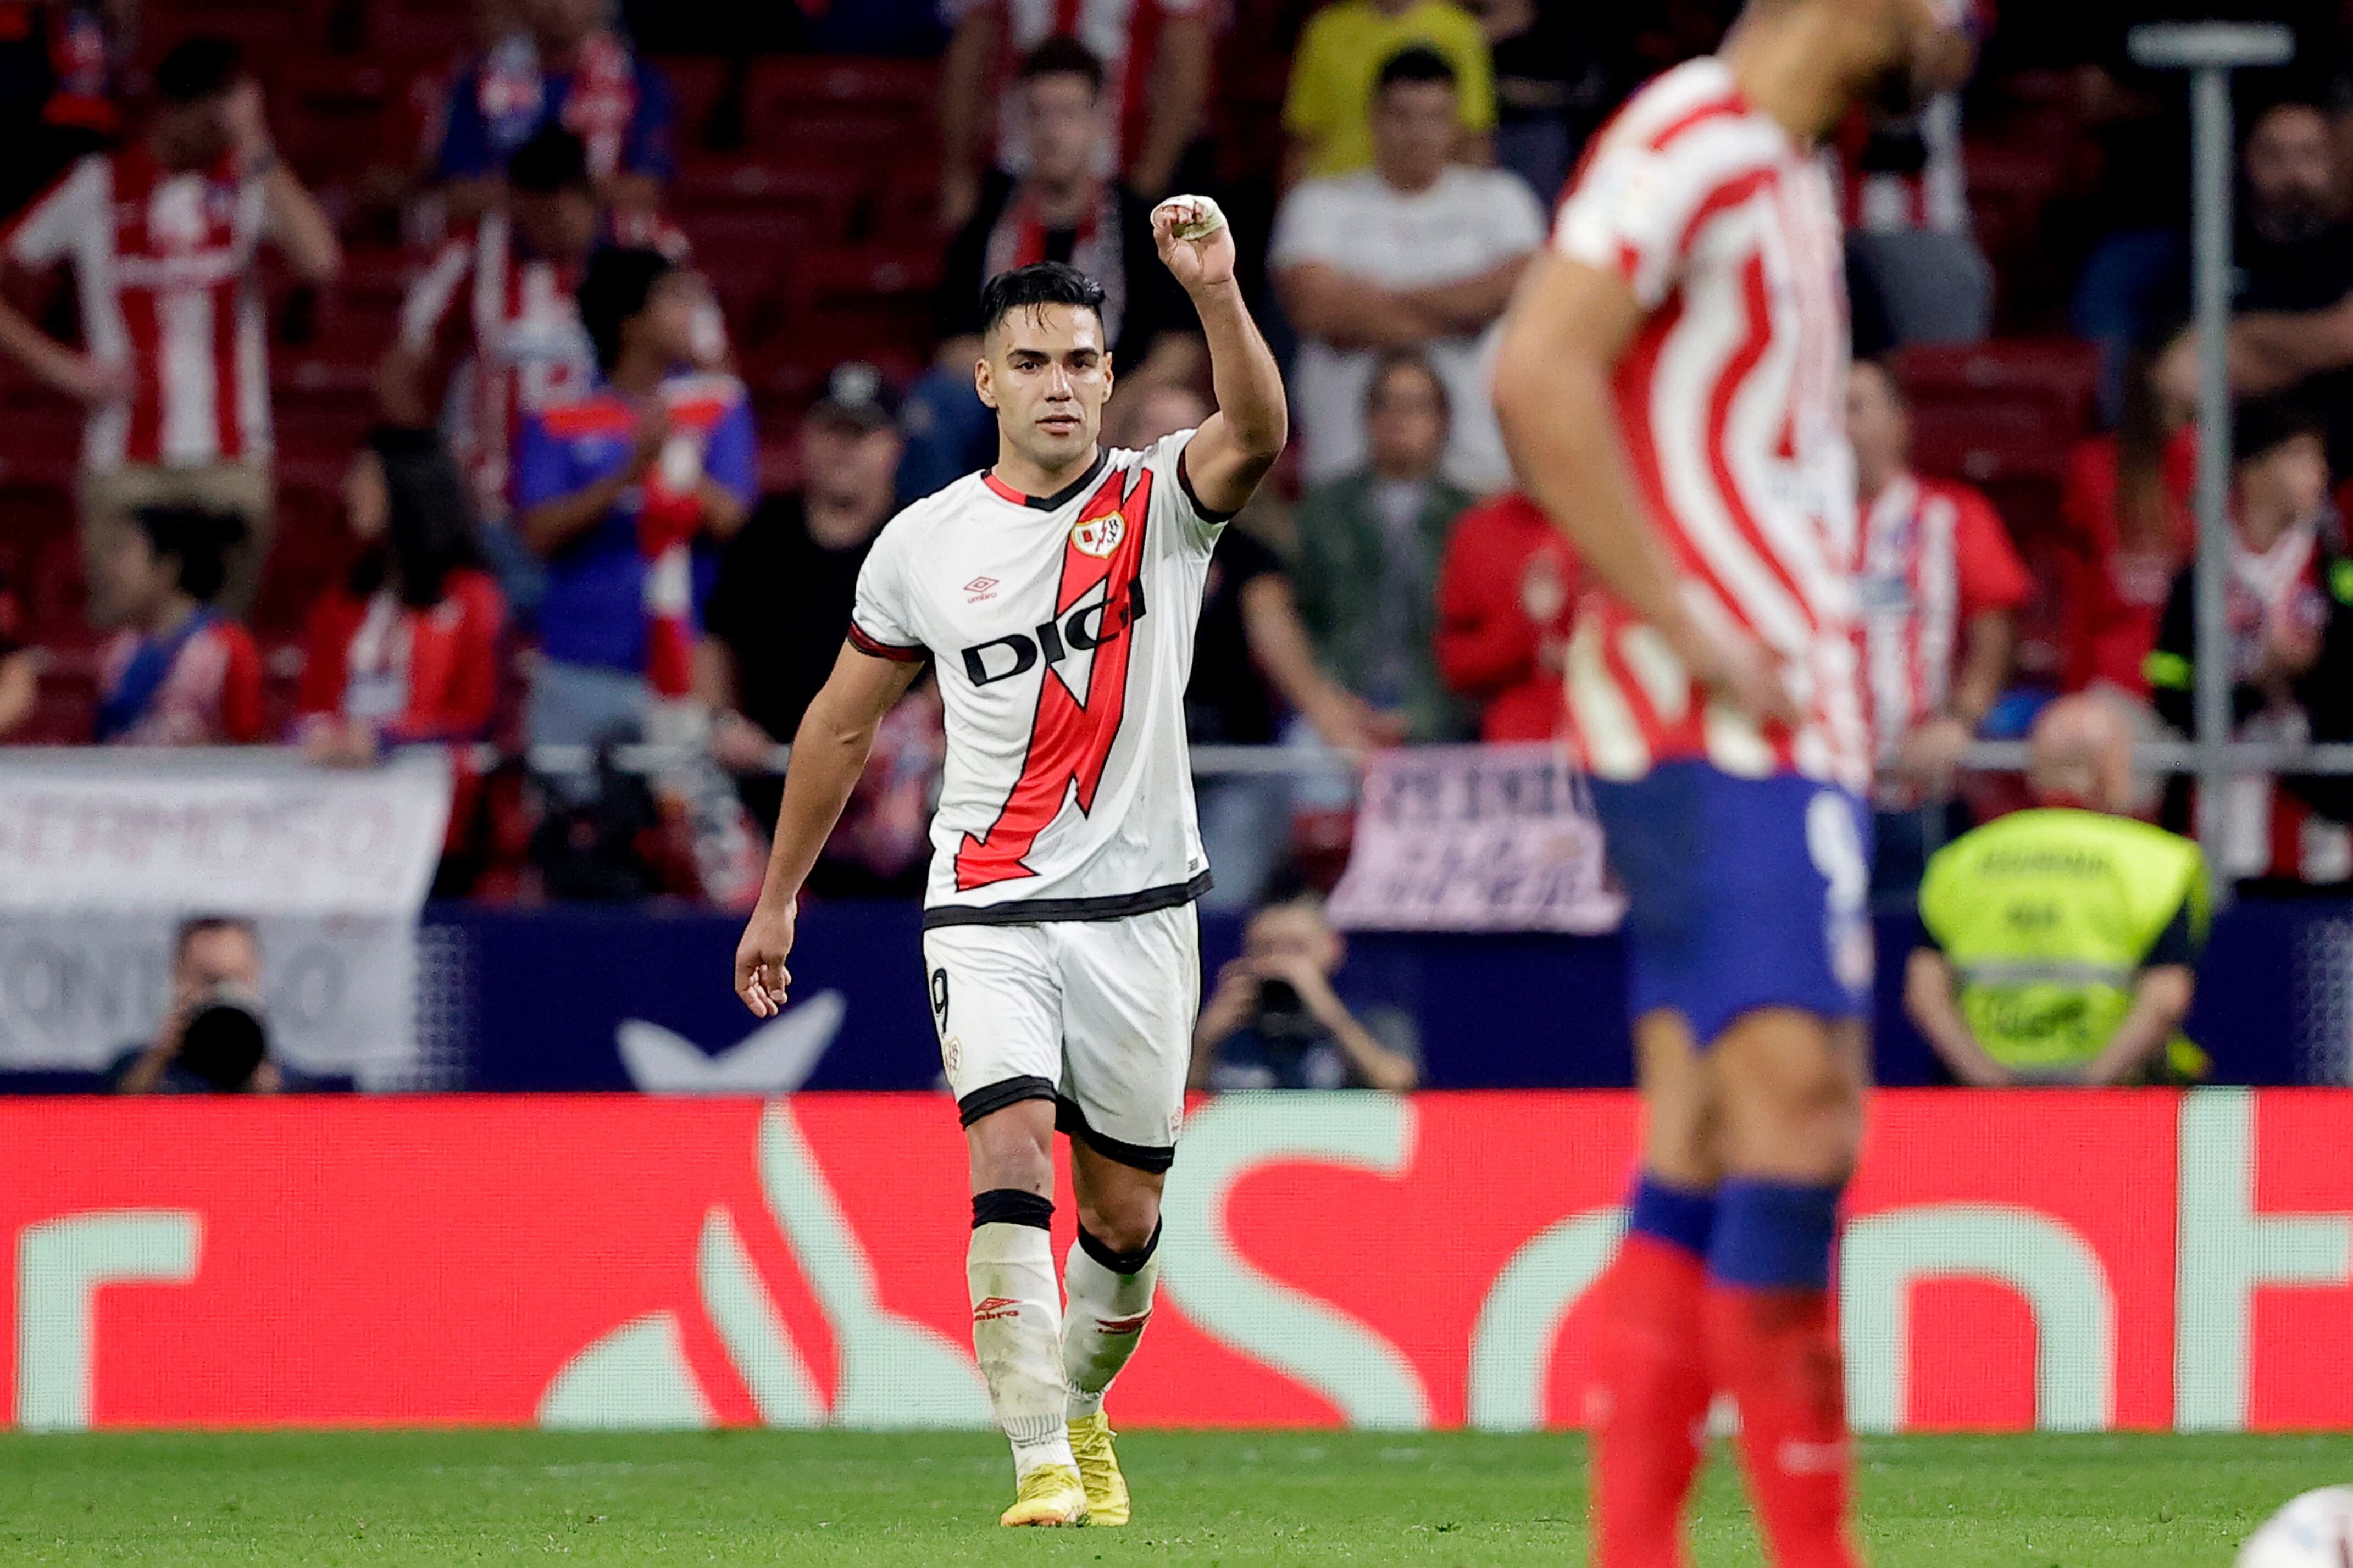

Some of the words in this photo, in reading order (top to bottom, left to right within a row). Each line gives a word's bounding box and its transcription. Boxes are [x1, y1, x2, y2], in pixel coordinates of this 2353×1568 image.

[967, 592, 997, 604] umbro
[931, 968, 949, 1033] 9
[974, 1310, 1020, 1321] mbro
